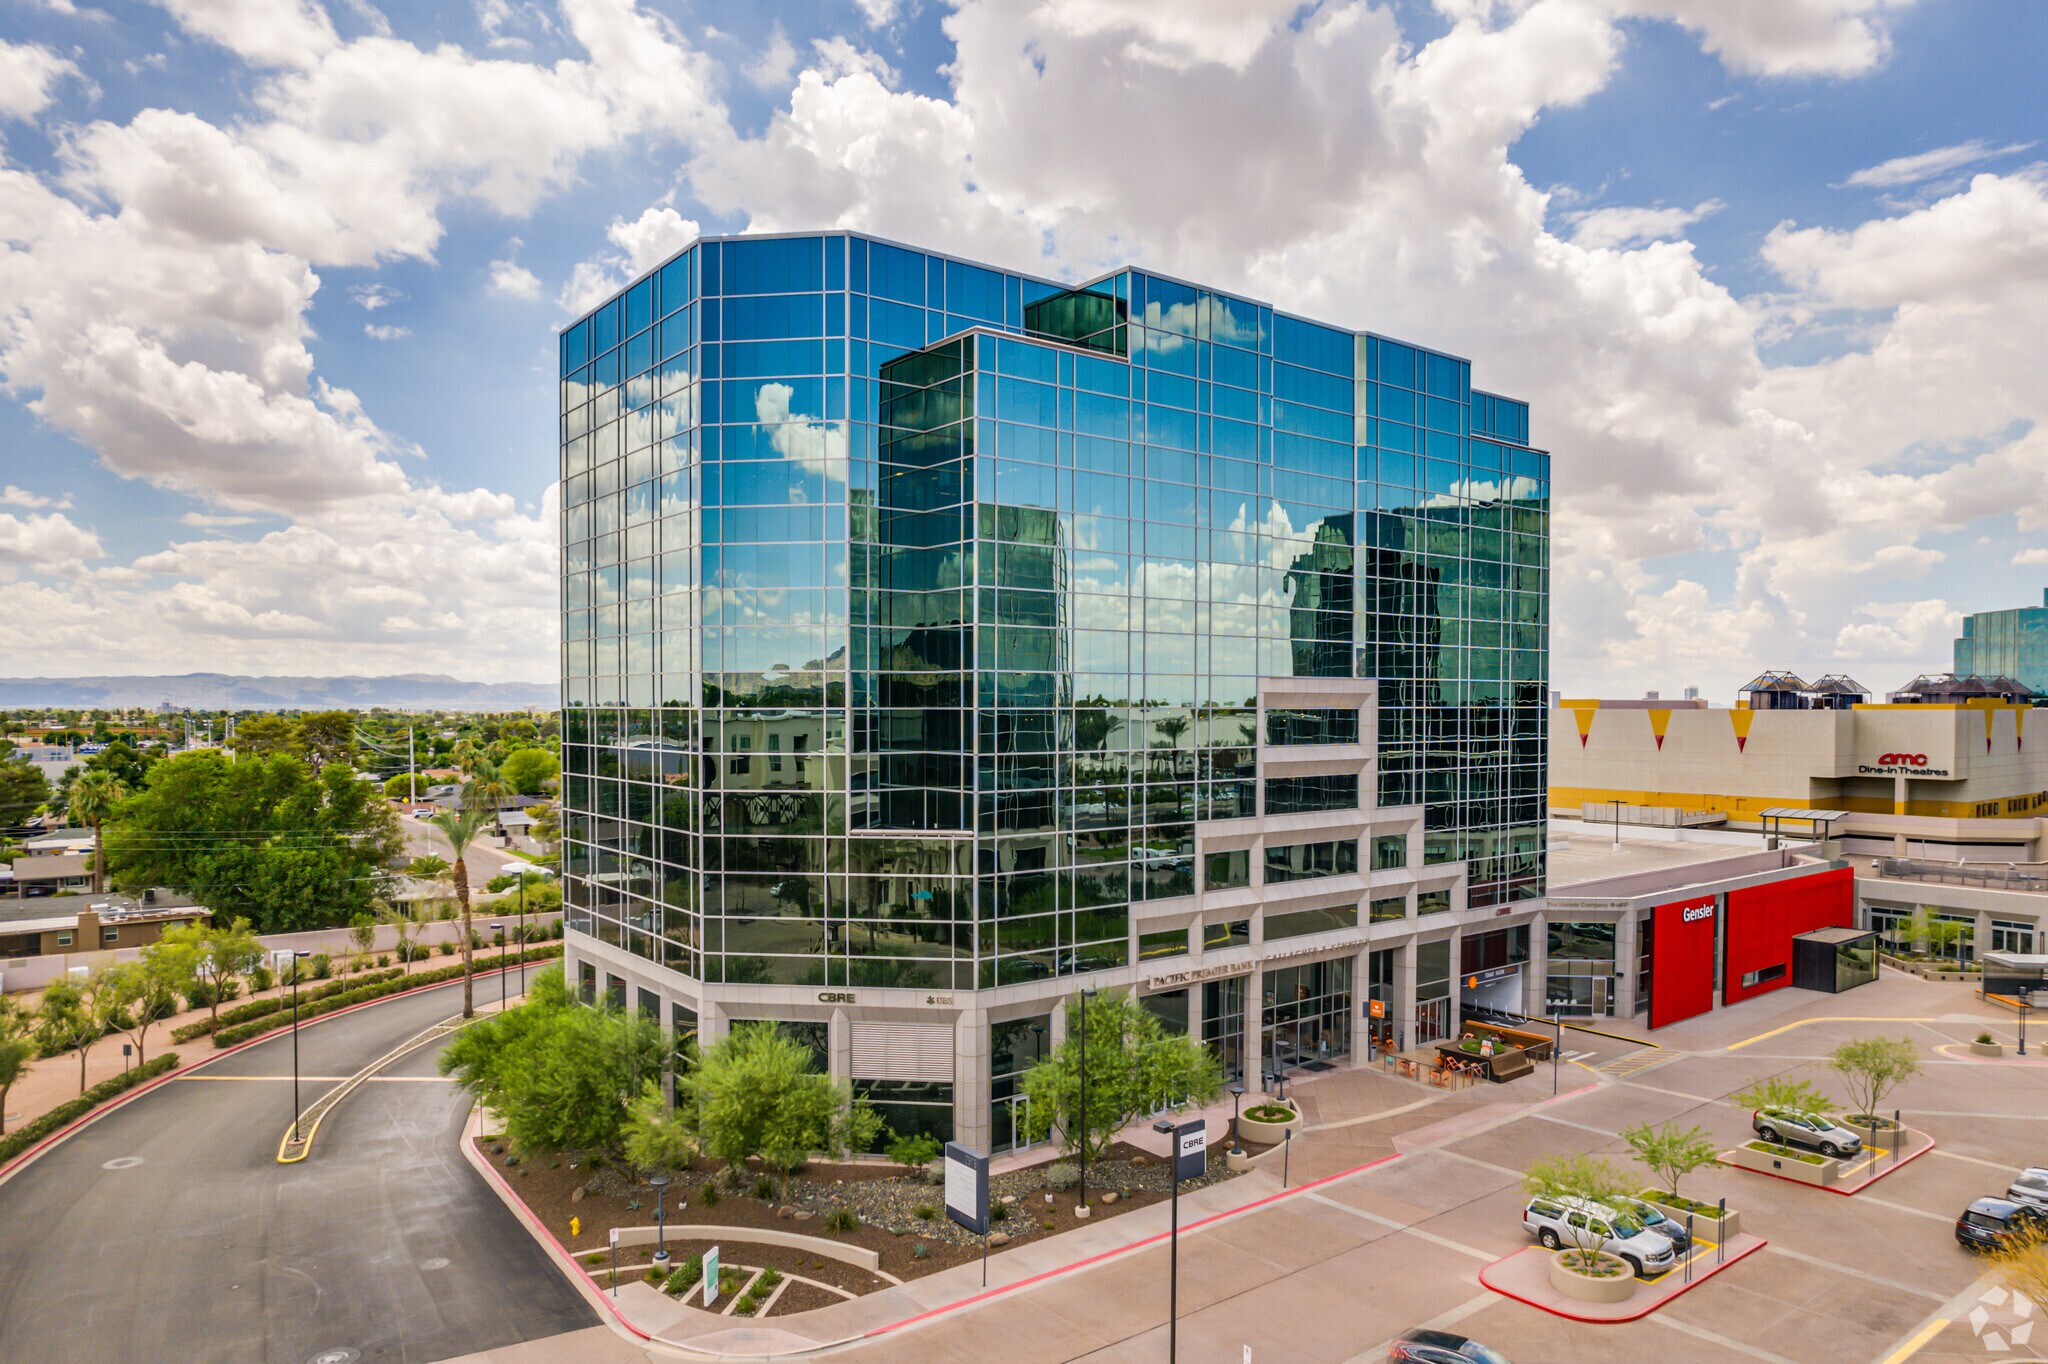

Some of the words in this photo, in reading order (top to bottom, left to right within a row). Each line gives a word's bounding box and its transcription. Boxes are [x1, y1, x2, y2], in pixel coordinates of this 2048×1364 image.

[1878, 753, 1927, 766] amc
[1859, 765, 1898, 774] Dine-In
[1898, 766, 1948, 776] Theatres
[1683, 904, 1714, 922] Gensler
[1154, 972, 1190, 987] PACIFIC
[1191, 965, 1228, 979] PREMIER
[1230, 961, 1253, 972] BANK
[818, 993, 855, 1003] CBRE
[936, 997, 953, 1005] UBS
[1183, 1137, 1204, 1149] CBRE
